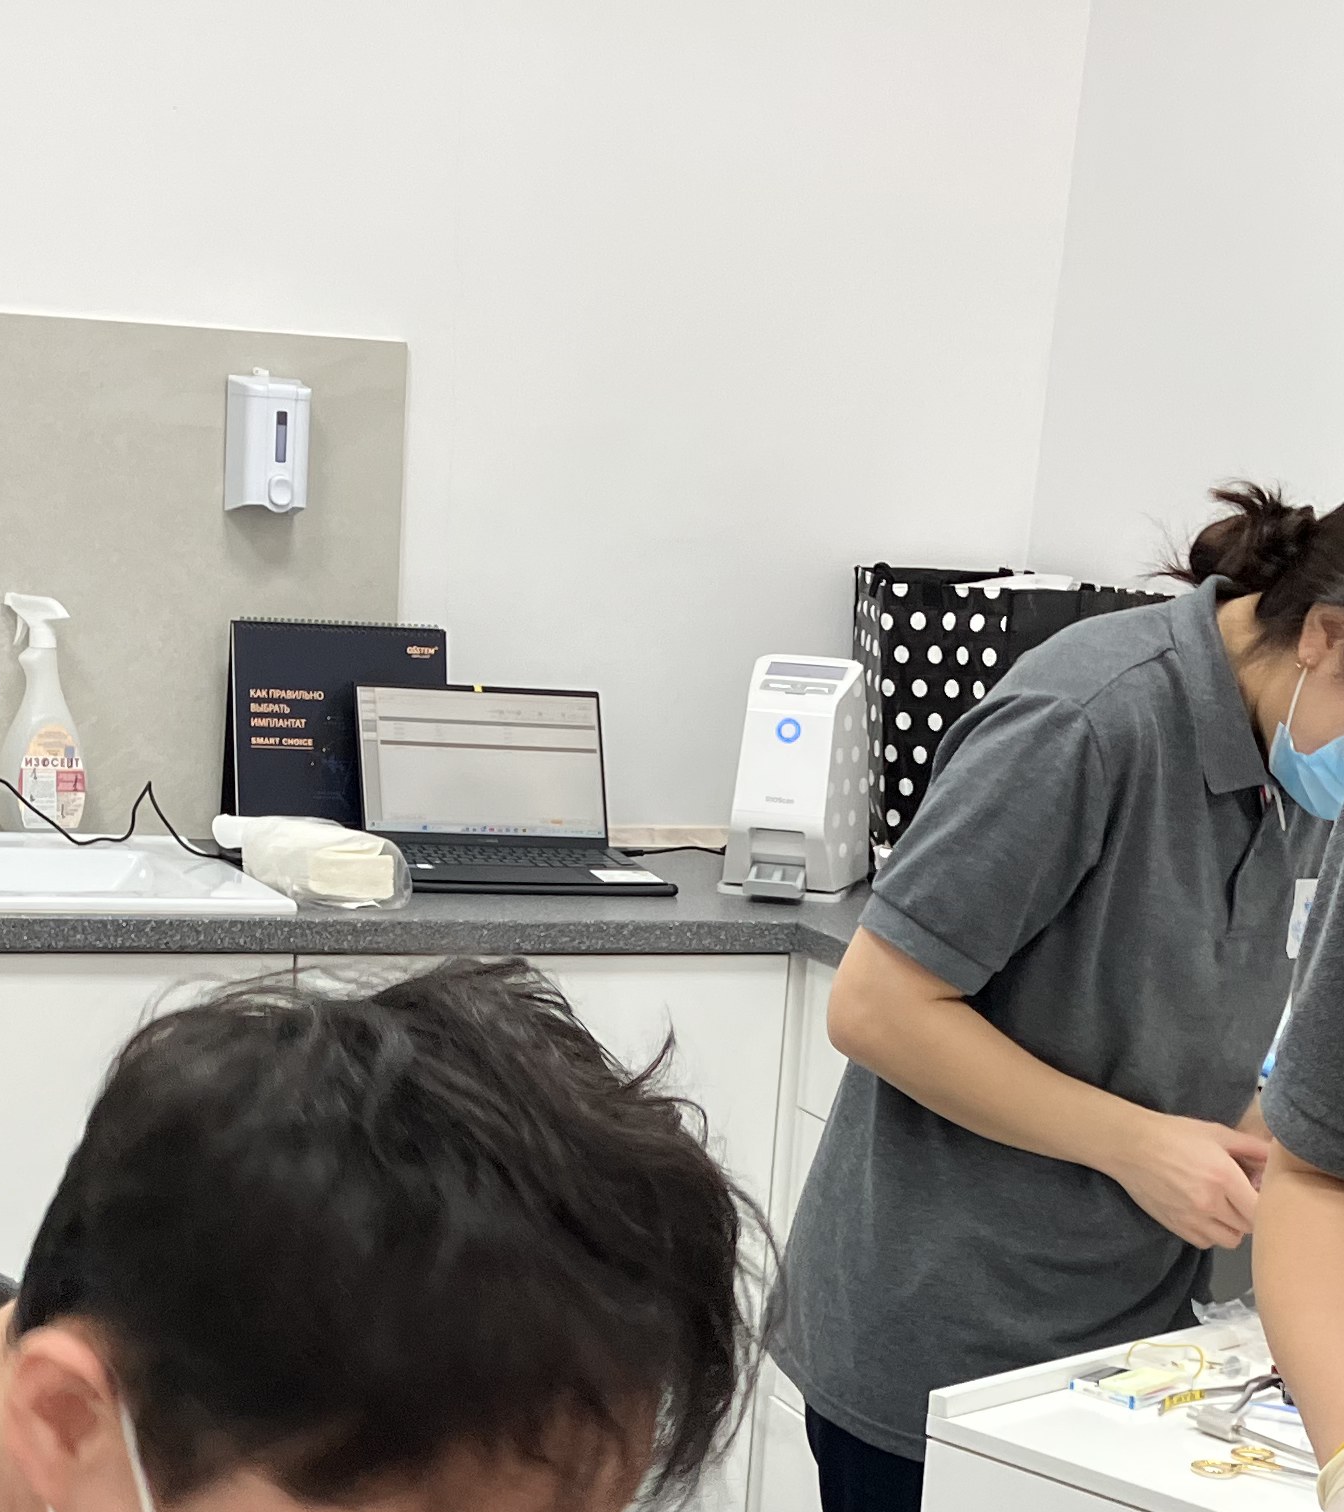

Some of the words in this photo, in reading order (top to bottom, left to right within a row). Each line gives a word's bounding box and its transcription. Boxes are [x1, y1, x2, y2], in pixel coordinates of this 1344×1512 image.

[249, 688, 268, 699] КАК
[269, 689, 325, 701] ПРАВИЛЬНО
[250, 702, 291, 714] ВЫБРАТЬ
[250, 717, 307, 729] ИМПЛАНТАТ
[250, 736, 280, 745] SMART
[281, 737, 314, 747] CHOICE
